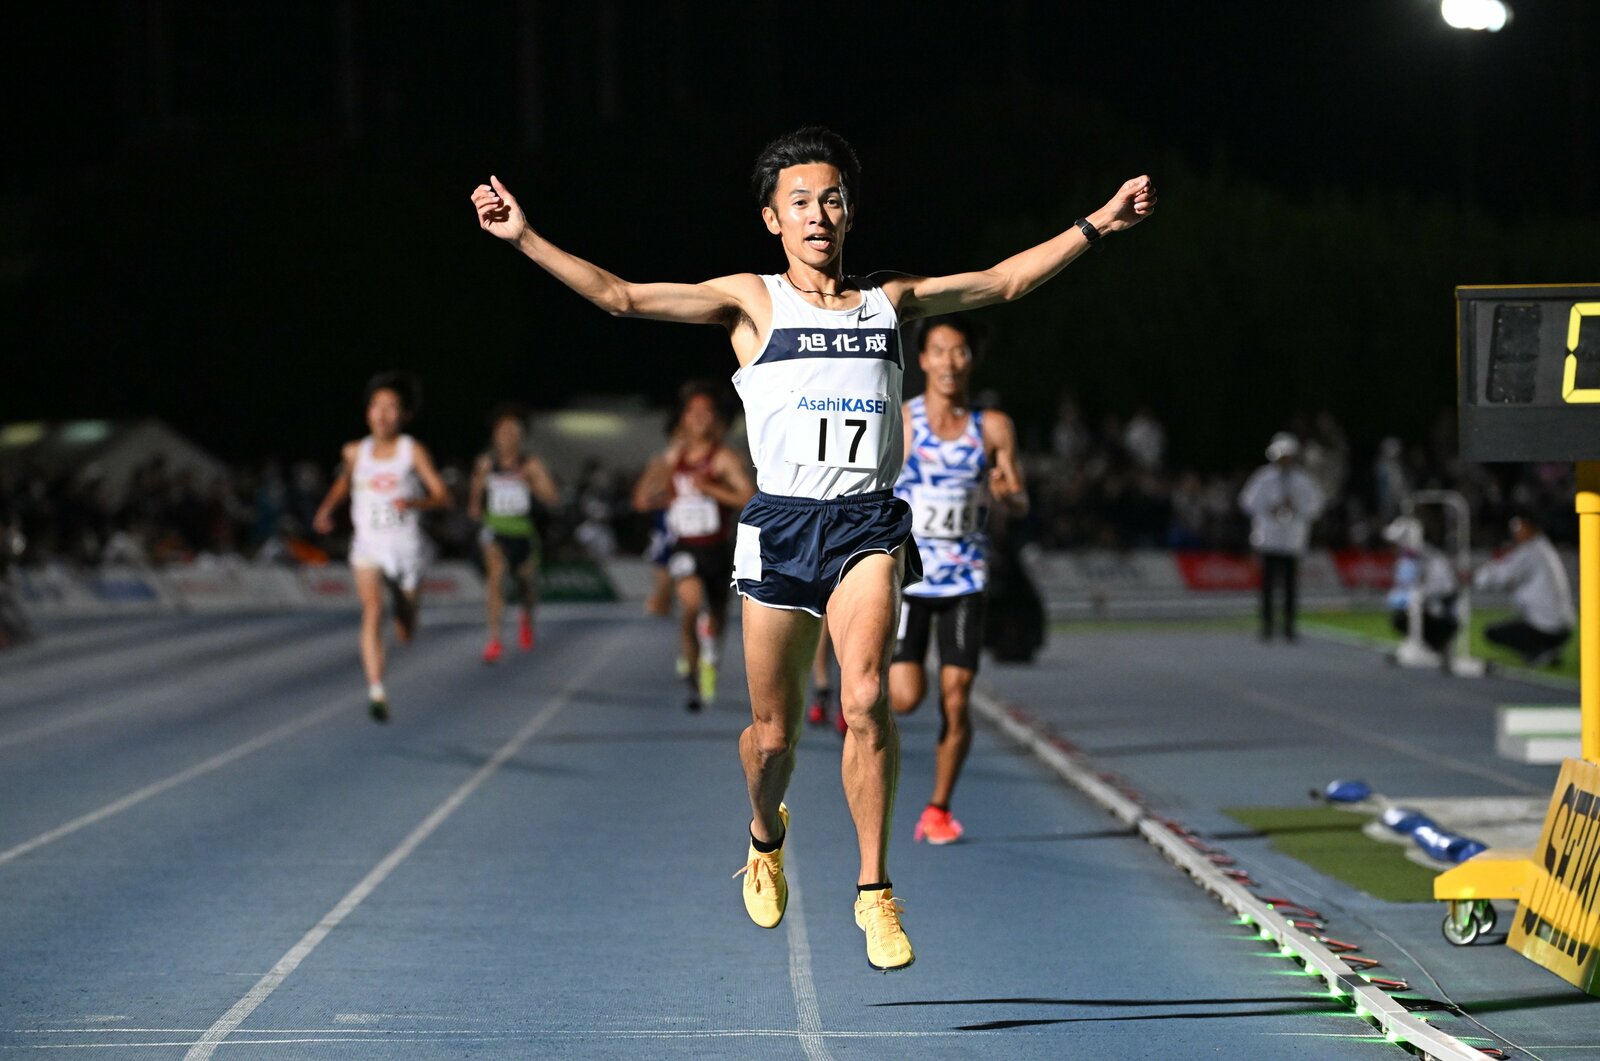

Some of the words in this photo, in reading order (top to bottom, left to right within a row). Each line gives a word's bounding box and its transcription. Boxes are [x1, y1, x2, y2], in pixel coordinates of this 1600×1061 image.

[797, 333, 888, 353] 旭化成
[797, 396, 887, 415] AsahiKASEI
[817, 417, 868, 463] 17
